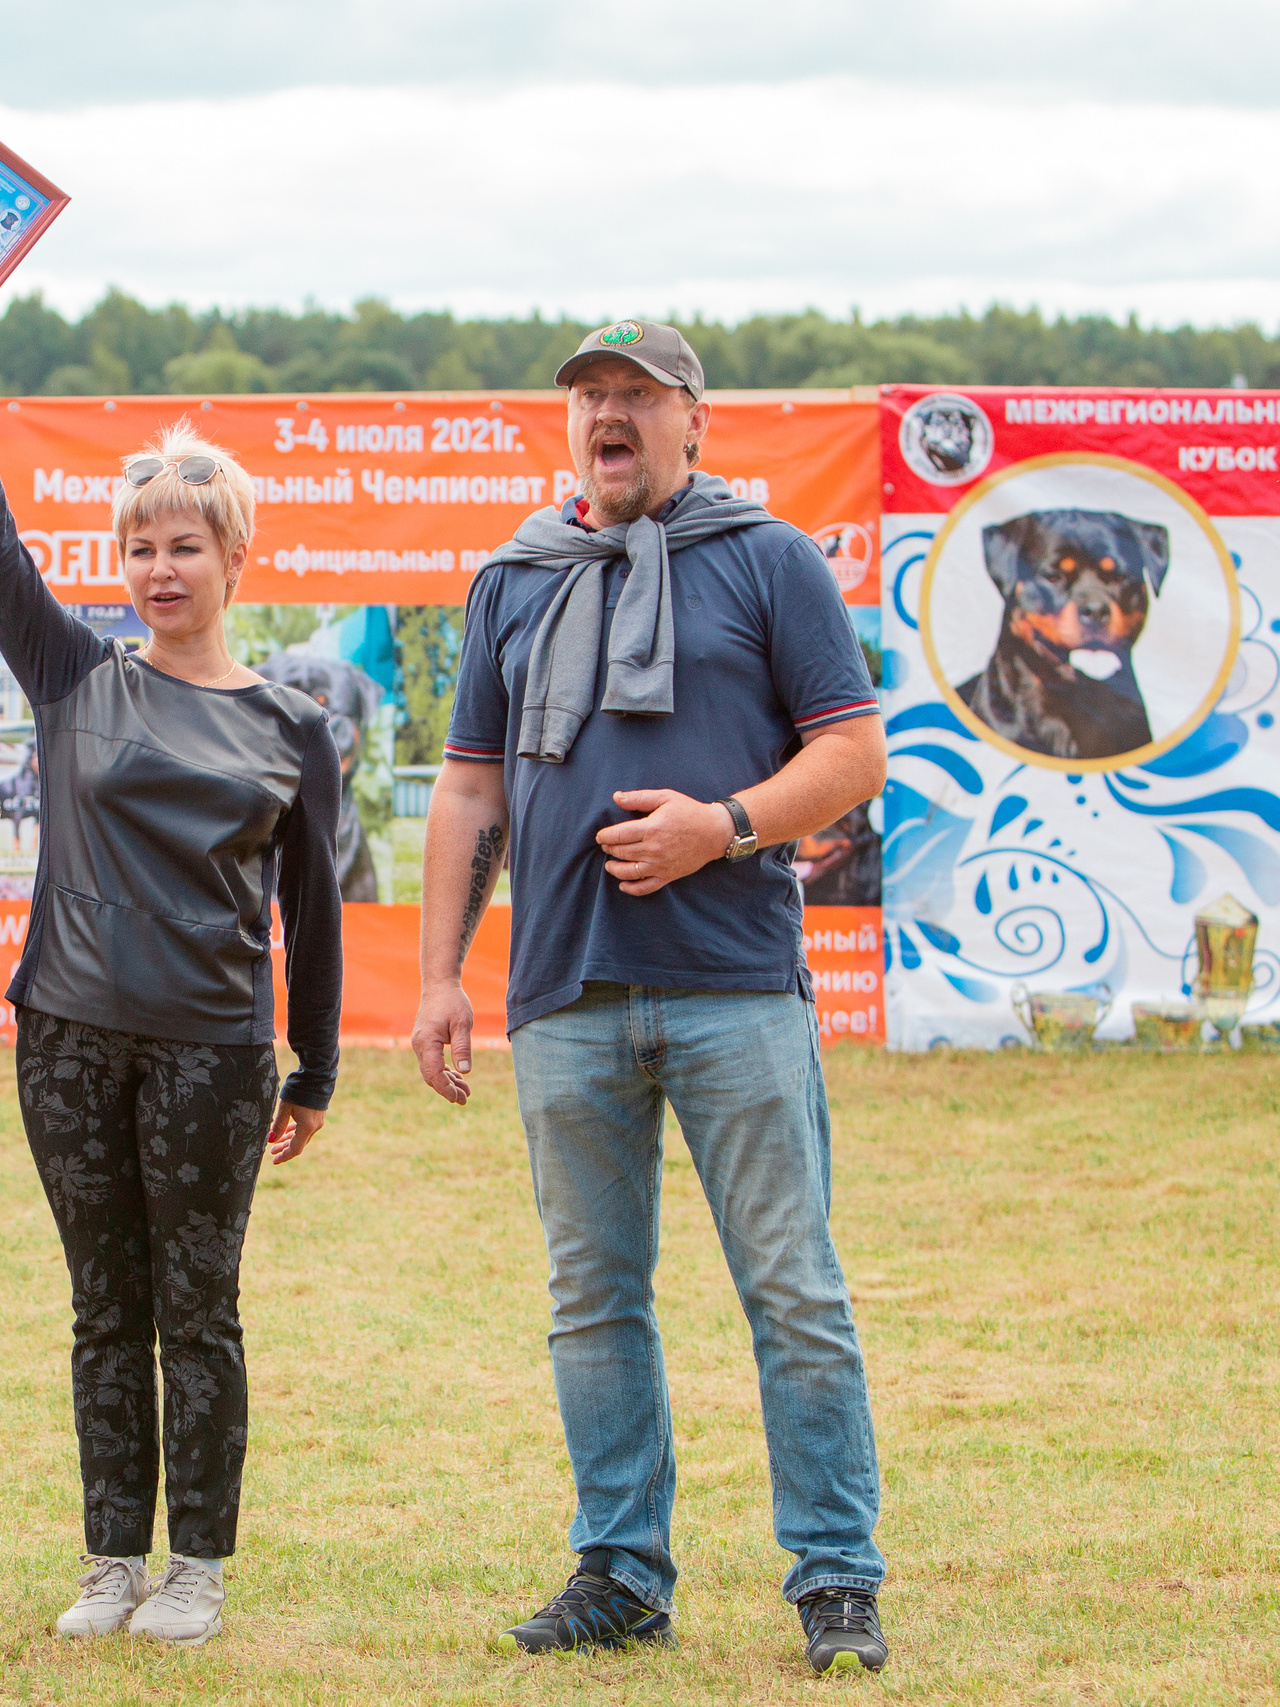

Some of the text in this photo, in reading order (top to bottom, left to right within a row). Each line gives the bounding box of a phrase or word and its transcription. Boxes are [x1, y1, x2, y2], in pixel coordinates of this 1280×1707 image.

[274, 417, 525, 453] 3-4 июля 2021г.
[1178, 446, 1278, 471] КУБОК
[360, 468, 545, 503] Чемпионат
[273, 543, 455, 577] официальные
